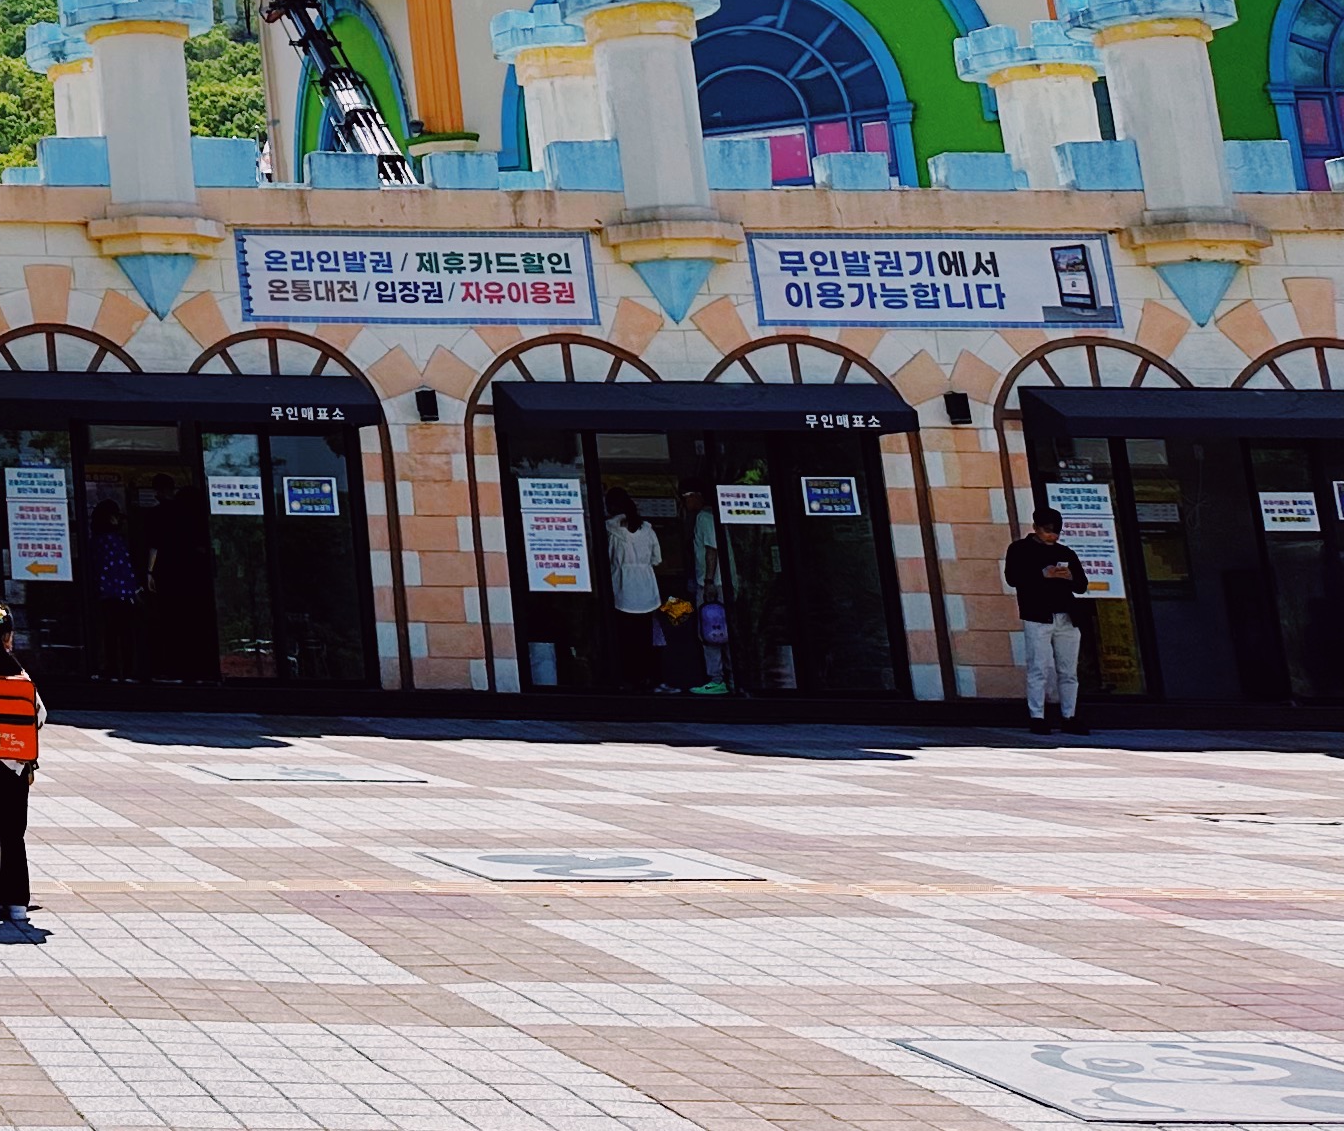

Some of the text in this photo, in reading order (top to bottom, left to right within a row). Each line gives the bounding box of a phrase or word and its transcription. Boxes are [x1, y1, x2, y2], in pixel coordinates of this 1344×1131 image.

[264, 250, 393, 274] 온라인발권
[416, 251, 572, 275] 제휴카드할인
[778, 251, 1000, 278] 무인발권기에서
[267, 279, 359, 302] 온통대전
[375, 280, 444, 304] 입장권
[460, 282, 576, 305] 자유이용권
[785, 282, 1006, 310] 이용가능합니다
[270, 406, 345, 421] 무인매표소
[805, 414, 882, 429] 무인매표소
